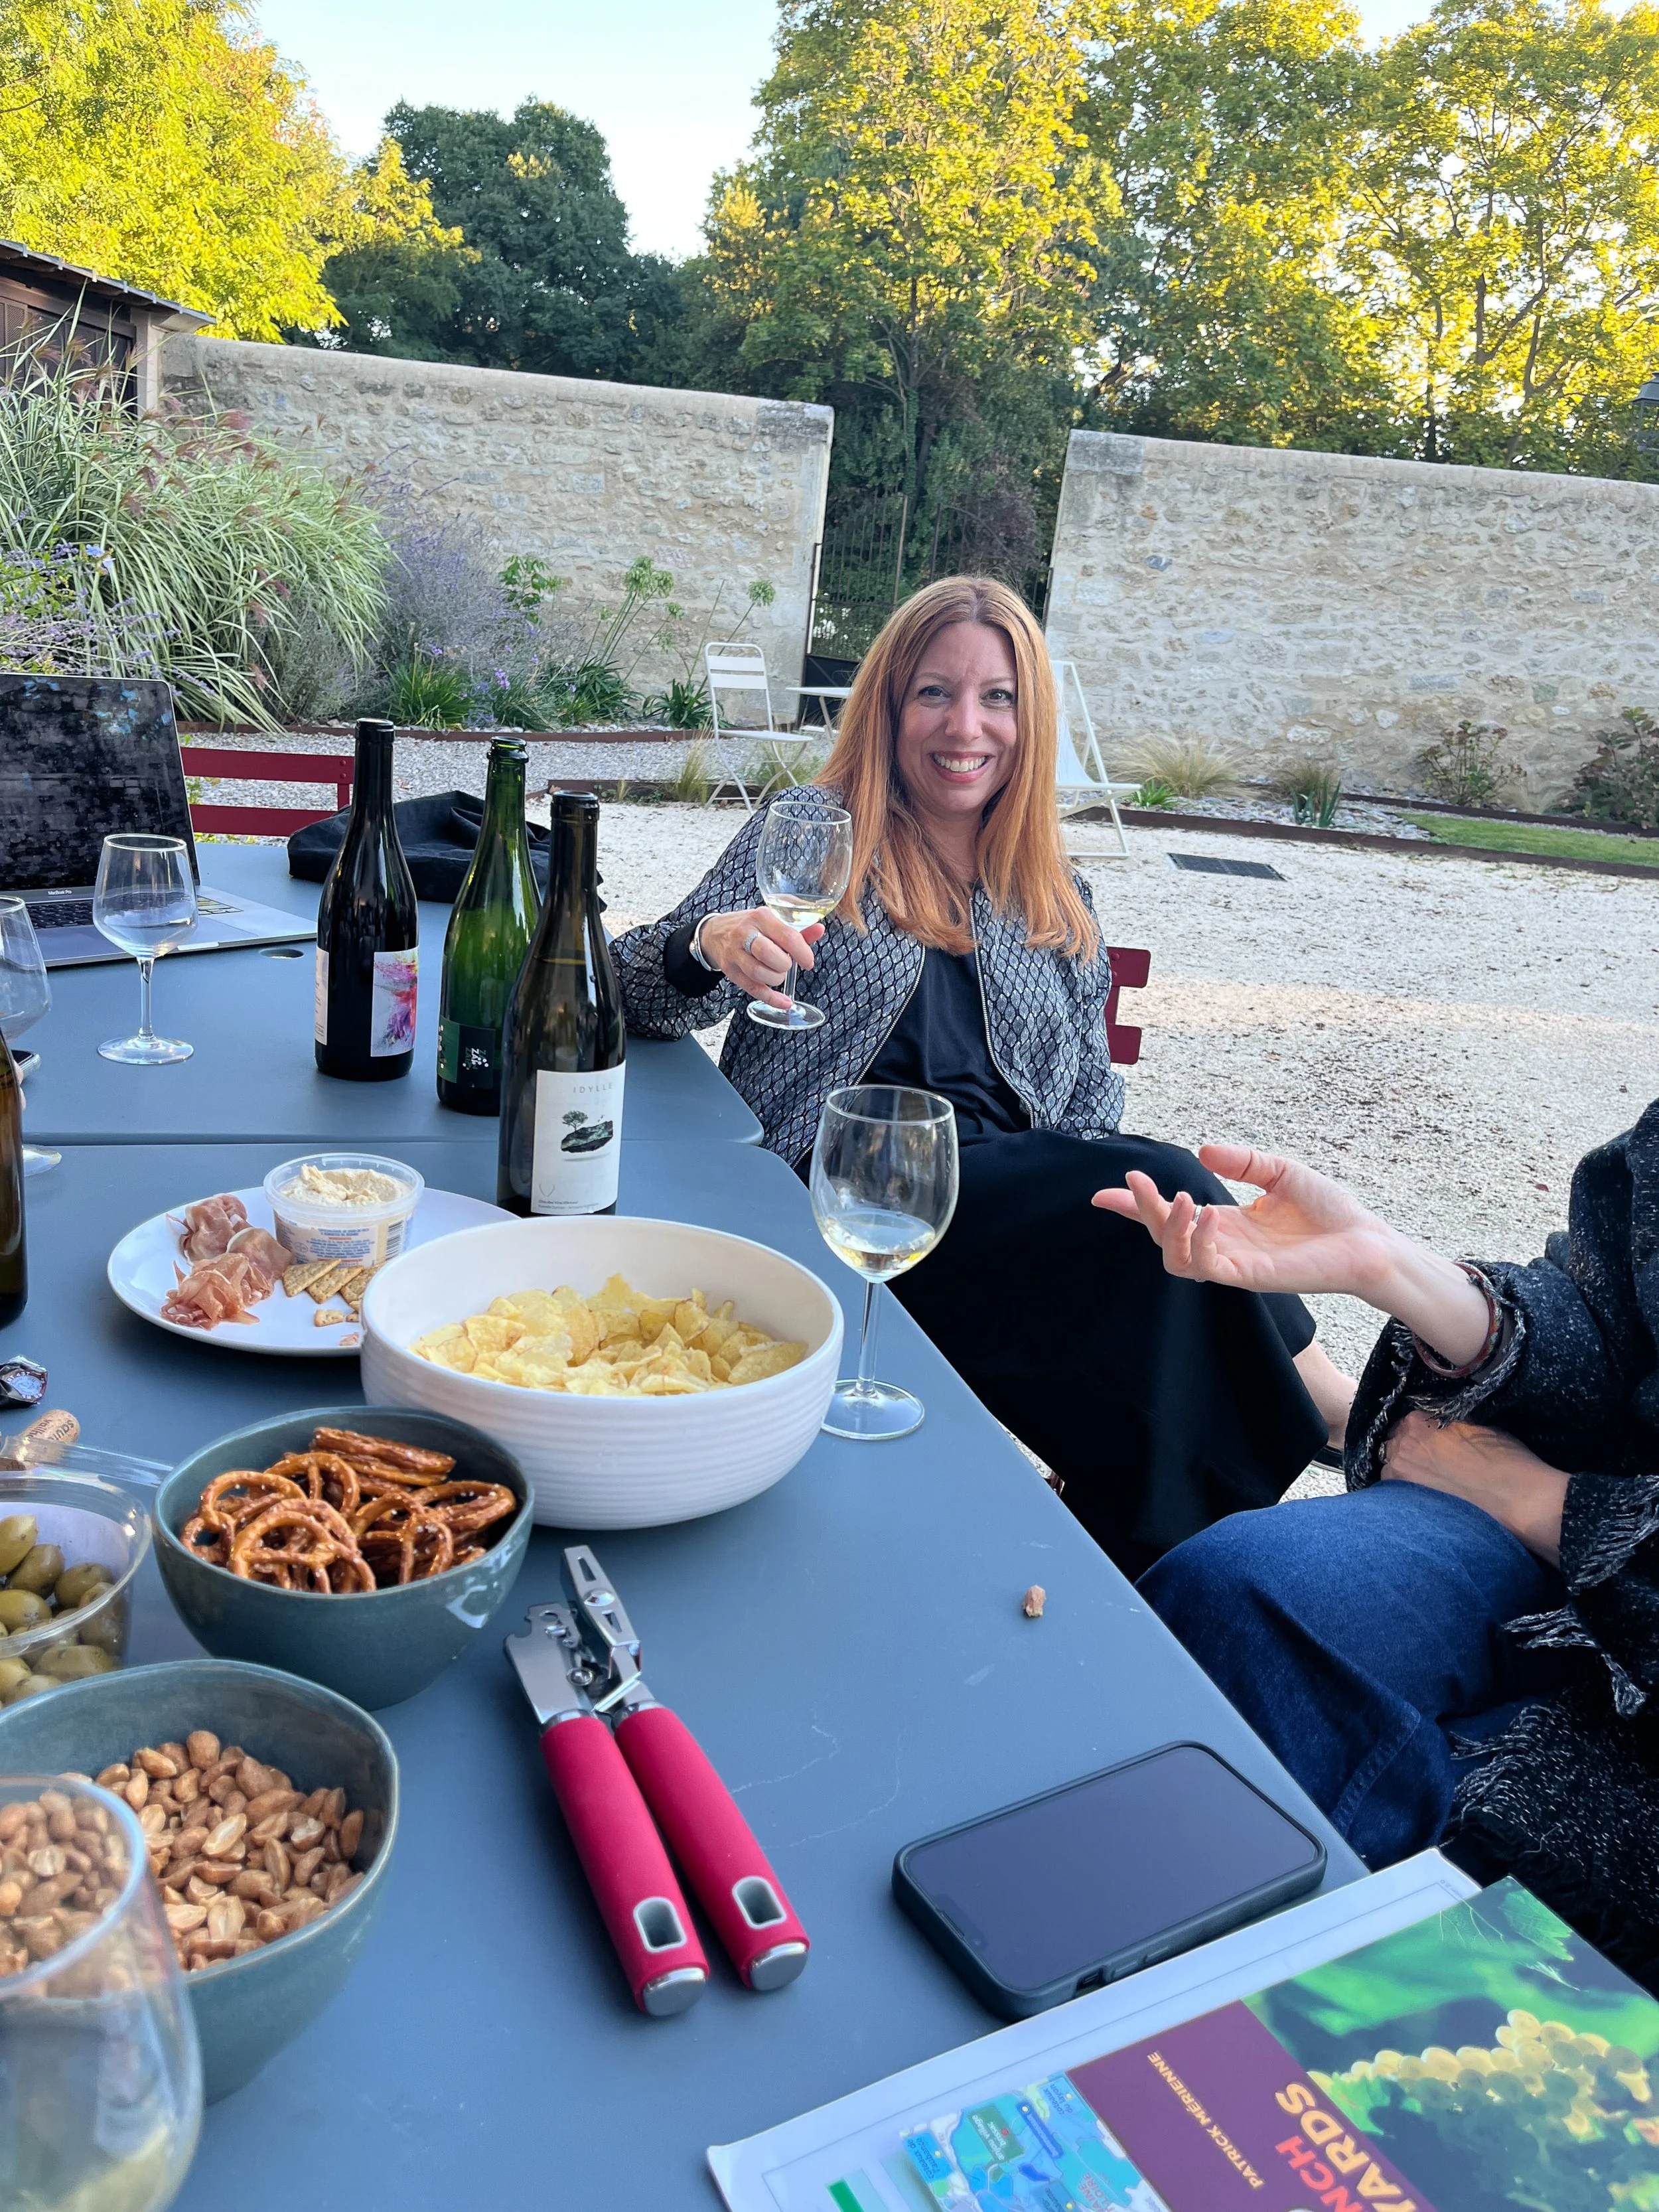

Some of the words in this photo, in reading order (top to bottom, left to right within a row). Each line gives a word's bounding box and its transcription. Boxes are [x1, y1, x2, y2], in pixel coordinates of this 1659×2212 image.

[573, 1082, 613, 1094] IDYLLE
[1043, 2089, 1066, 2116] coteaux
[1050, 2083, 1068, 2104] layon
[1147, 2051, 1212, 2128] MÉRIENNE
[1063, 2102, 1074, 2114] du
[971, 2114, 991, 2141] village
[907, 2138, 918, 2153] de
[988, 2136, 1005, 2161] anjou
[1206, 2124, 1265, 2190] PATRICK
[913, 2150, 935, 2179] coteaux
